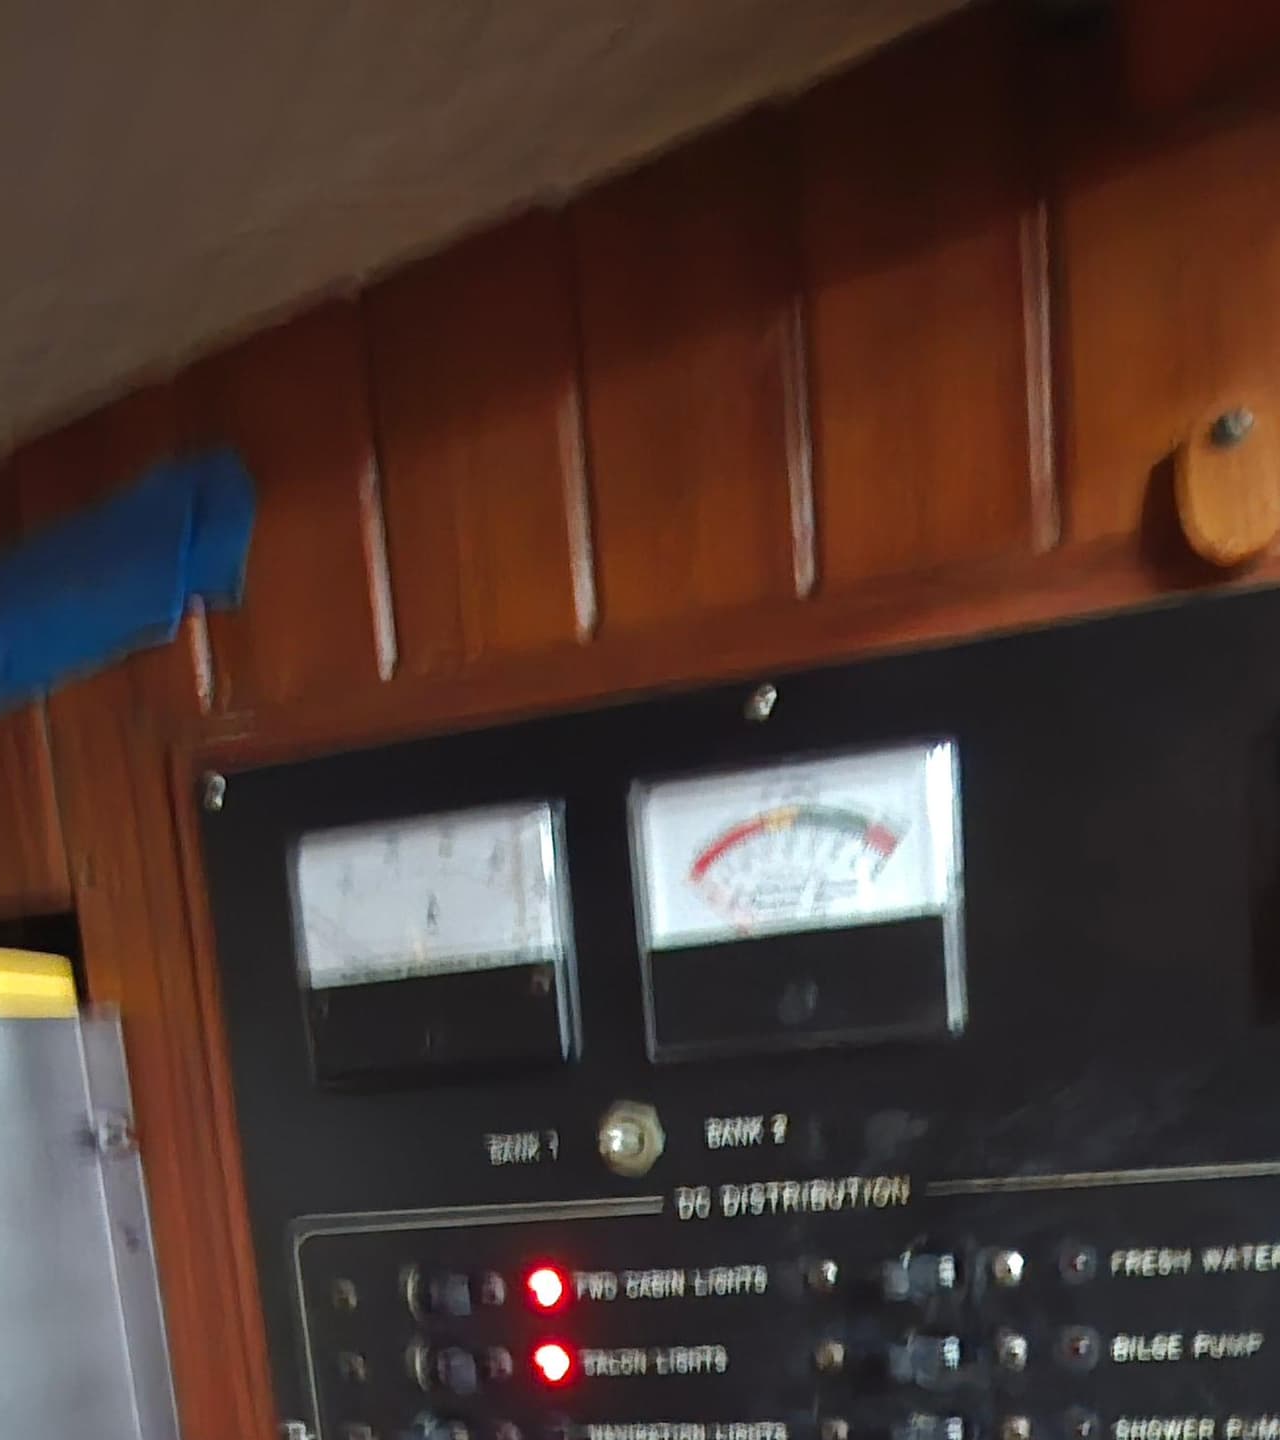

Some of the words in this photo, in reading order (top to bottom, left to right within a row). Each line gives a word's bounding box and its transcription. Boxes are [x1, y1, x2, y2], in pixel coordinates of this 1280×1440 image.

[705, 1115, 764, 1149] BANK
[772, 1113, 789, 1144] 2
[485, 1132, 540, 1165] BANK
[720, 1174, 911, 1216] DISTRIBUTION
[1111, 1247, 1192, 1277] FRESH
[623, 1269, 685, 1299] CABIN
[693, 1265, 768, 1296] LIGHTS
[655, 1345, 728, 1375] LIGHTS
[1111, 1333, 1184, 1362] BILGE
[1192, 1331, 1264, 1359] PUMP
